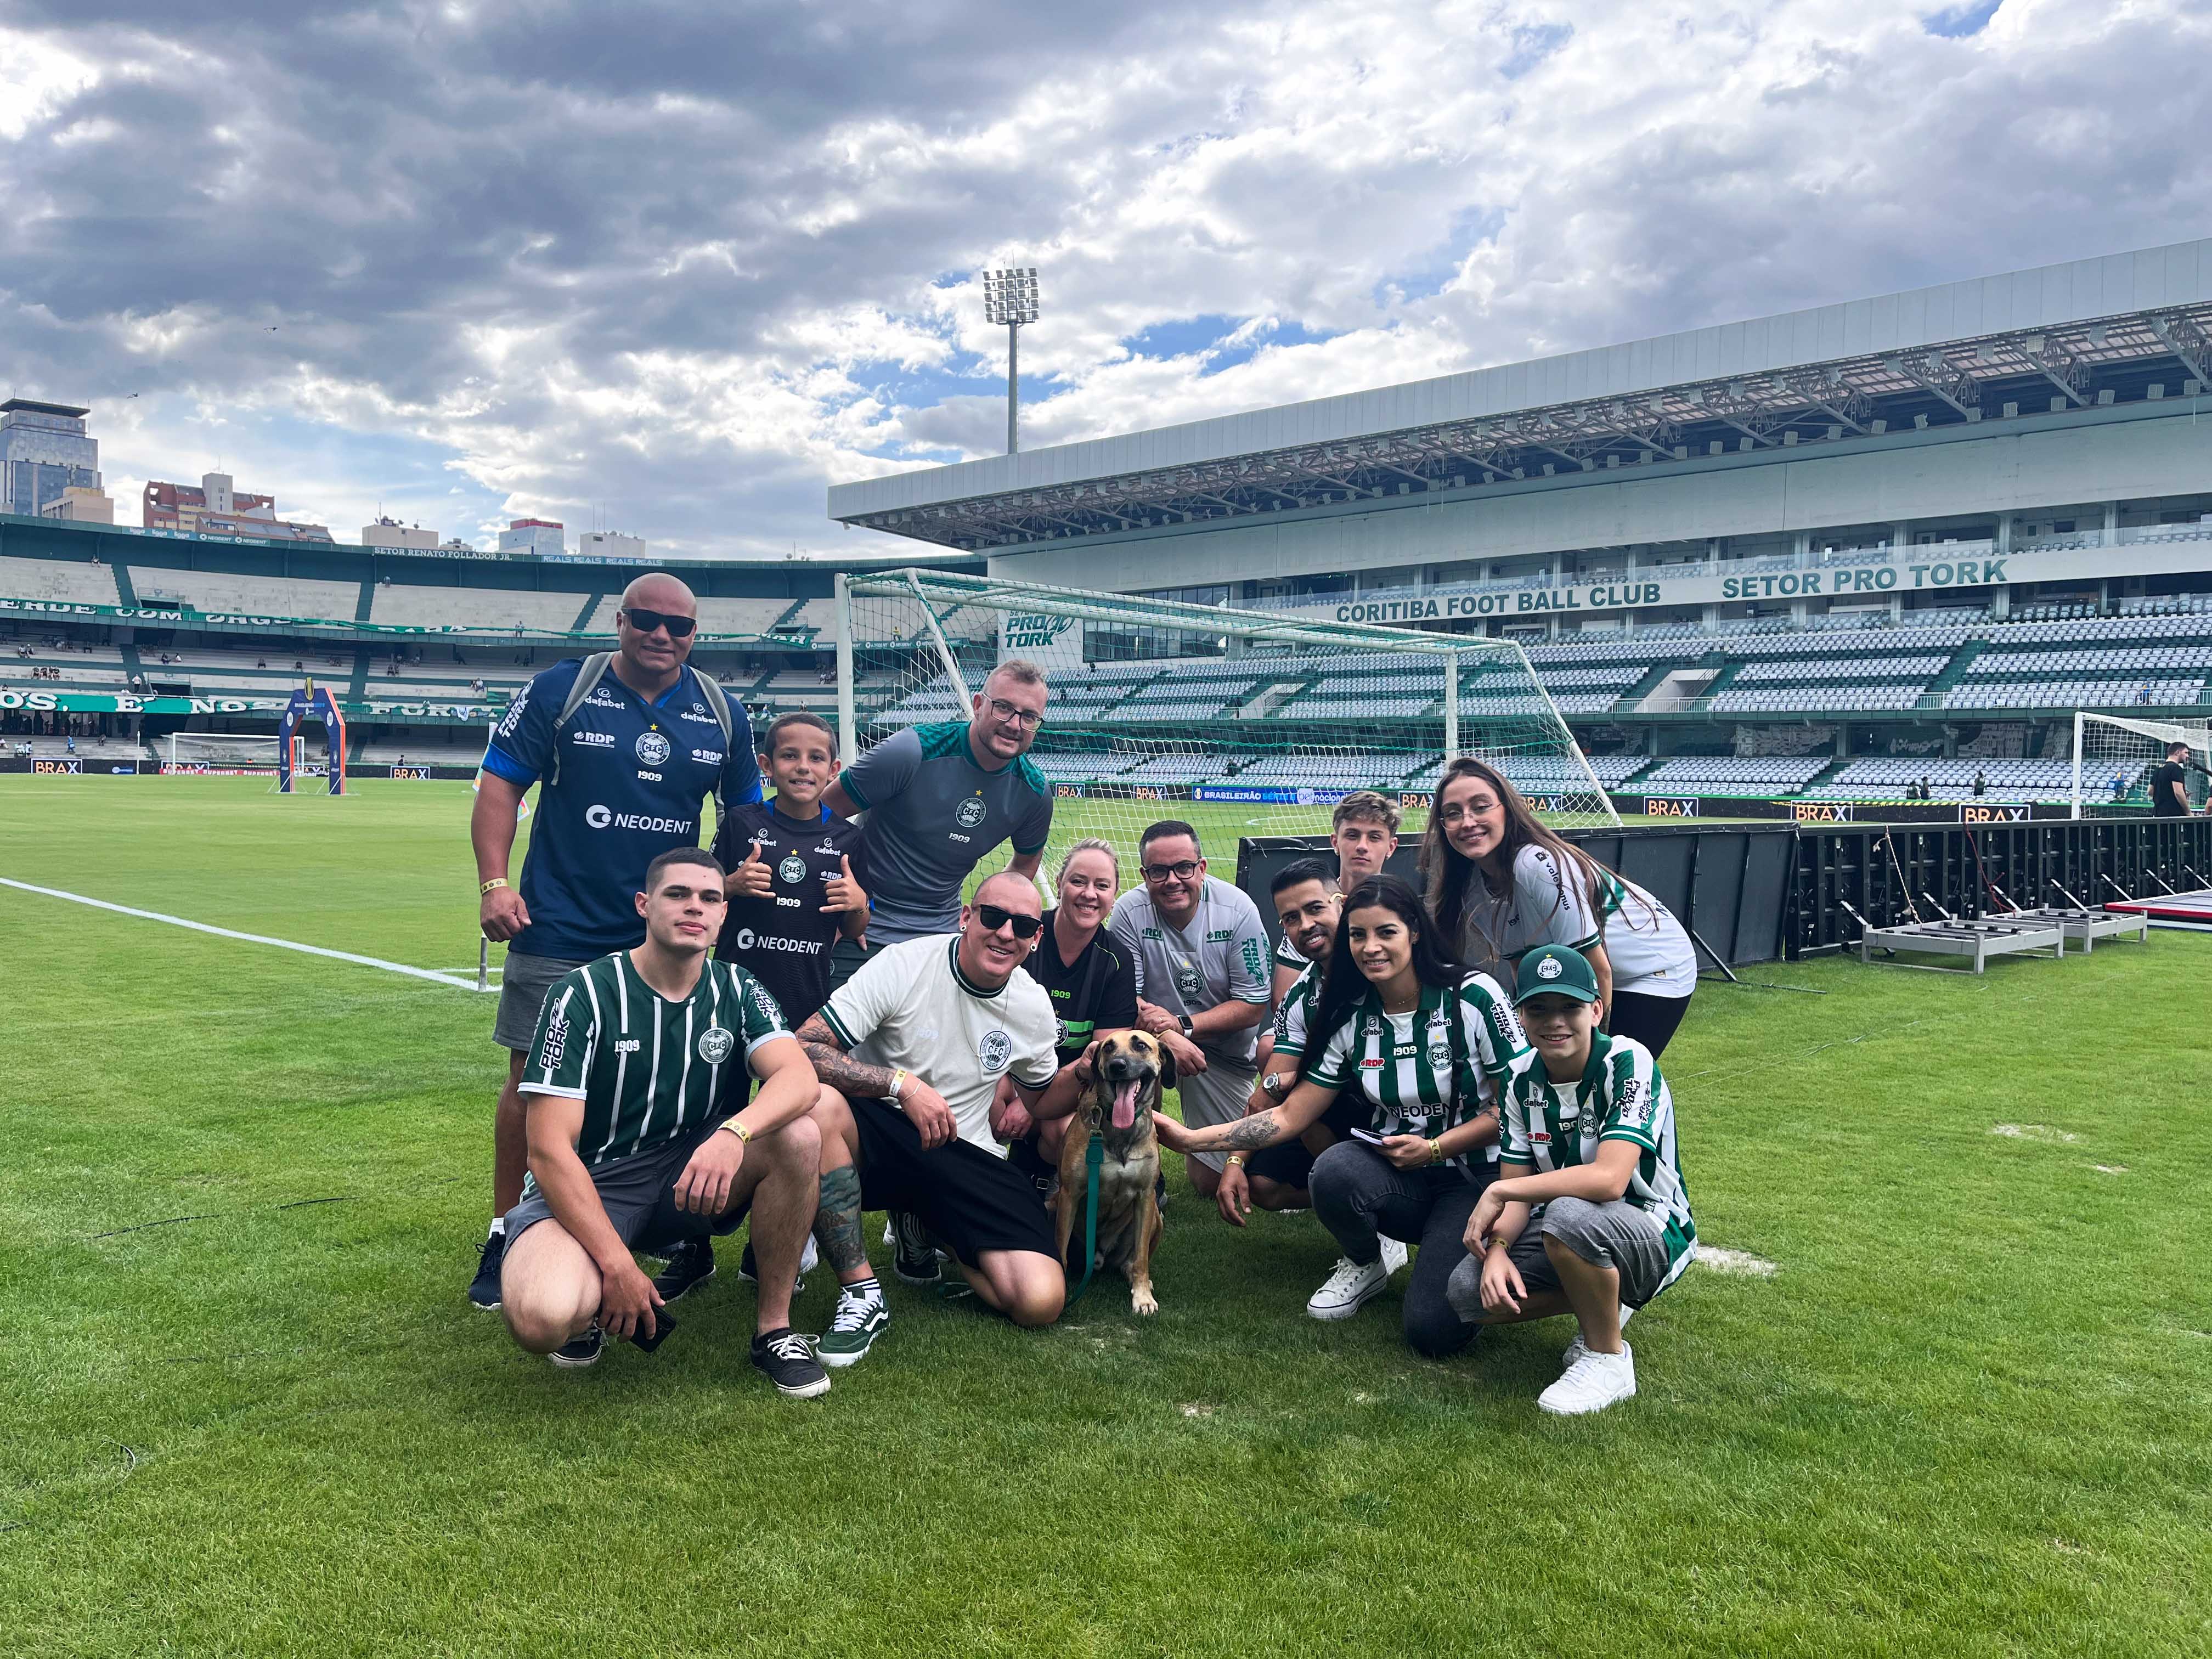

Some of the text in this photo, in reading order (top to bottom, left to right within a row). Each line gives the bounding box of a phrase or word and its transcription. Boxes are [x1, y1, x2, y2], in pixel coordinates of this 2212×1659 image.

[374, 548, 405, 556] SETOR
[408, 549, 445, 558] RENATO
[448, 551, 496, 560] FOLLADOR
[1722, 559, 2008, 598] SETOR PRO TORK
[1337, 584, 1661, 622] CORITIBA FOOT BALL CLUB
[1006, 615, 1046, 632] PRO
[1005, 631, 1053, 648] TORK
[585, 696, 625, 709] dafabet
[681, 712, 717, 724] dafabet
[585, 732, 615, 744] RDP
[644, 743, 662, 753] CFC
[702, 750, 723, 761] RDP
[36, 761, 78, 774] BRAX
[394, 768, 426, 780] BRAX
[637, 770, 662, 782] 1909
[1058, 786, 1082, 798] BRAX
[1136, 787, 1163, 800] BRAX
[1204, 790, 1261, 800] BRASILEIRÃO
[963, 807, 979, 817] CFC
[1649, 800, 1694, 817] BRAX
[1796, 805, 1847, 822] BRAX
[1965, 808, 2024, 822] BRAX
[614, 813, 692, 834] NEODENT
[748, 837, 777, 847] dafabet
[949, 832, 970, 843] 1909
[814, 846, 840, 856] dafabet
[776, 896, 801, 908] 1909
[757, 935, 823, 955] NEODENT
[1250, 938, 1261, 966] PRO
[1051, 989, 1071, 999] 1909
[1491, 1003, 1506, 1036] TORK
[1496, 1003, 1510, 1026] PRO
[540, 1028, 556, 1069] PRO
[550, 1018, 569, 1069] TORK
[614, 1040, 640, 1052] 1909
[709, 1041, 725, 1051] CFC
[988, 1045, 1003, 1056] CFC
[1393, 1046, 1418, 1056] 1909
[1432, 1052, 1448, 1060] CFC
[1365, 1059, 1384, 1067] RDP
[1390, 1103, 1450, 1119] NEODEN
[1583, 1119, 1594, 1127] CFC
